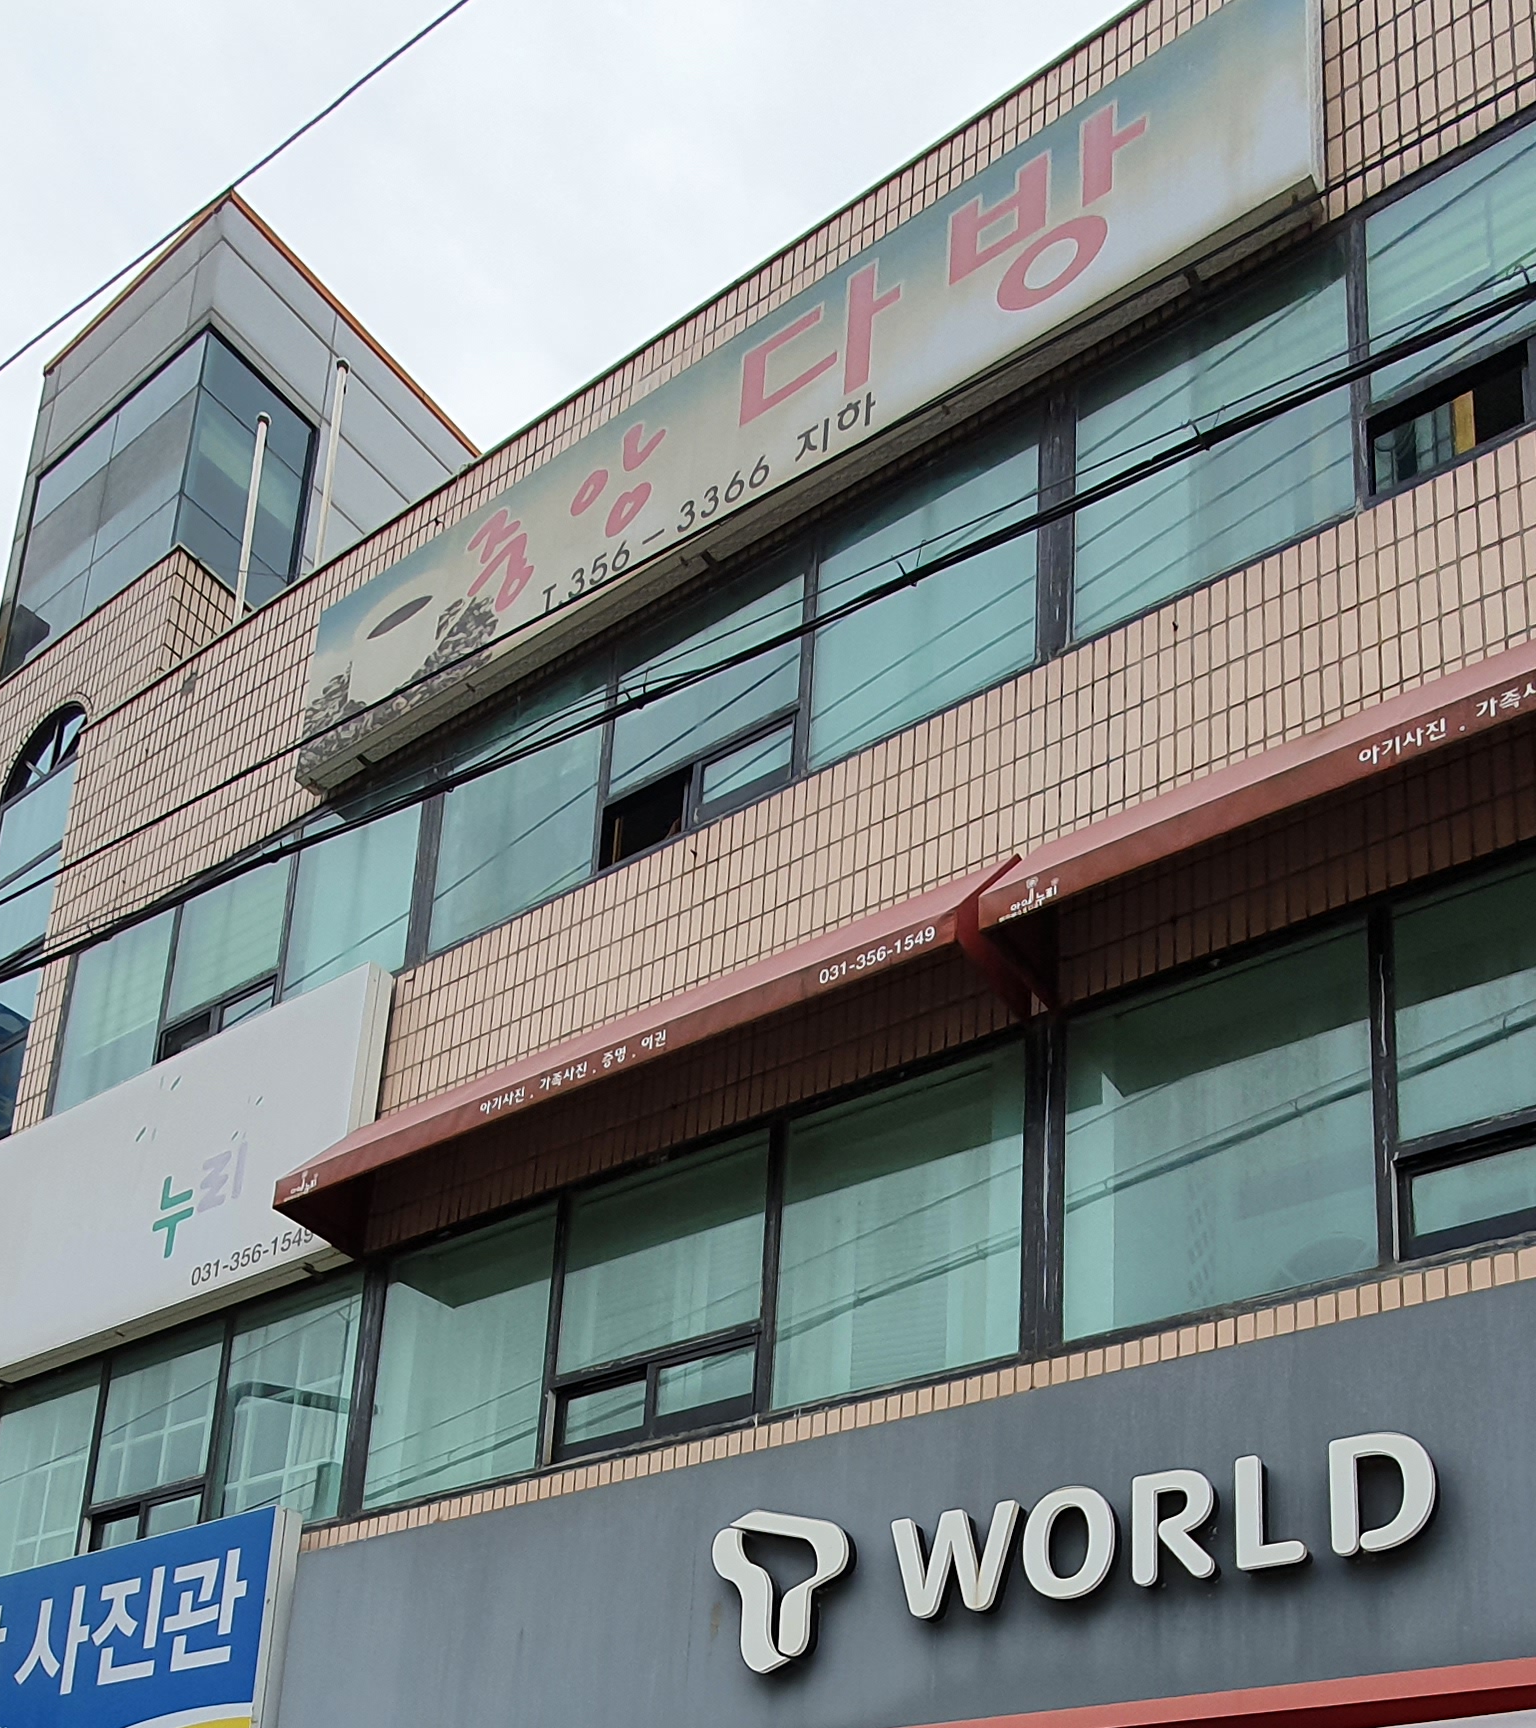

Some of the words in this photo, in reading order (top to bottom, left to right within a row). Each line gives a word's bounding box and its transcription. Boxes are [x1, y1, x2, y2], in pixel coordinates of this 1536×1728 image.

[795, 392, 876, 462] 지하
[1358, 717, 1447, 764] 아기사진
[818, 925, 936, 985] 031-356-1549
[479, 1086, 526, 1114] 아기사진
[539, 1061, 588, 1090] 가족사진
[601, 1045, 627, 1071] 증명
[641, 1029, 667, 1051] 여권
[191, 1228, 314, 1286] 031-356-1549
[890, 1431, 1437, 1620] WORLD
[14, 1547, 248, 1696] 사진관
